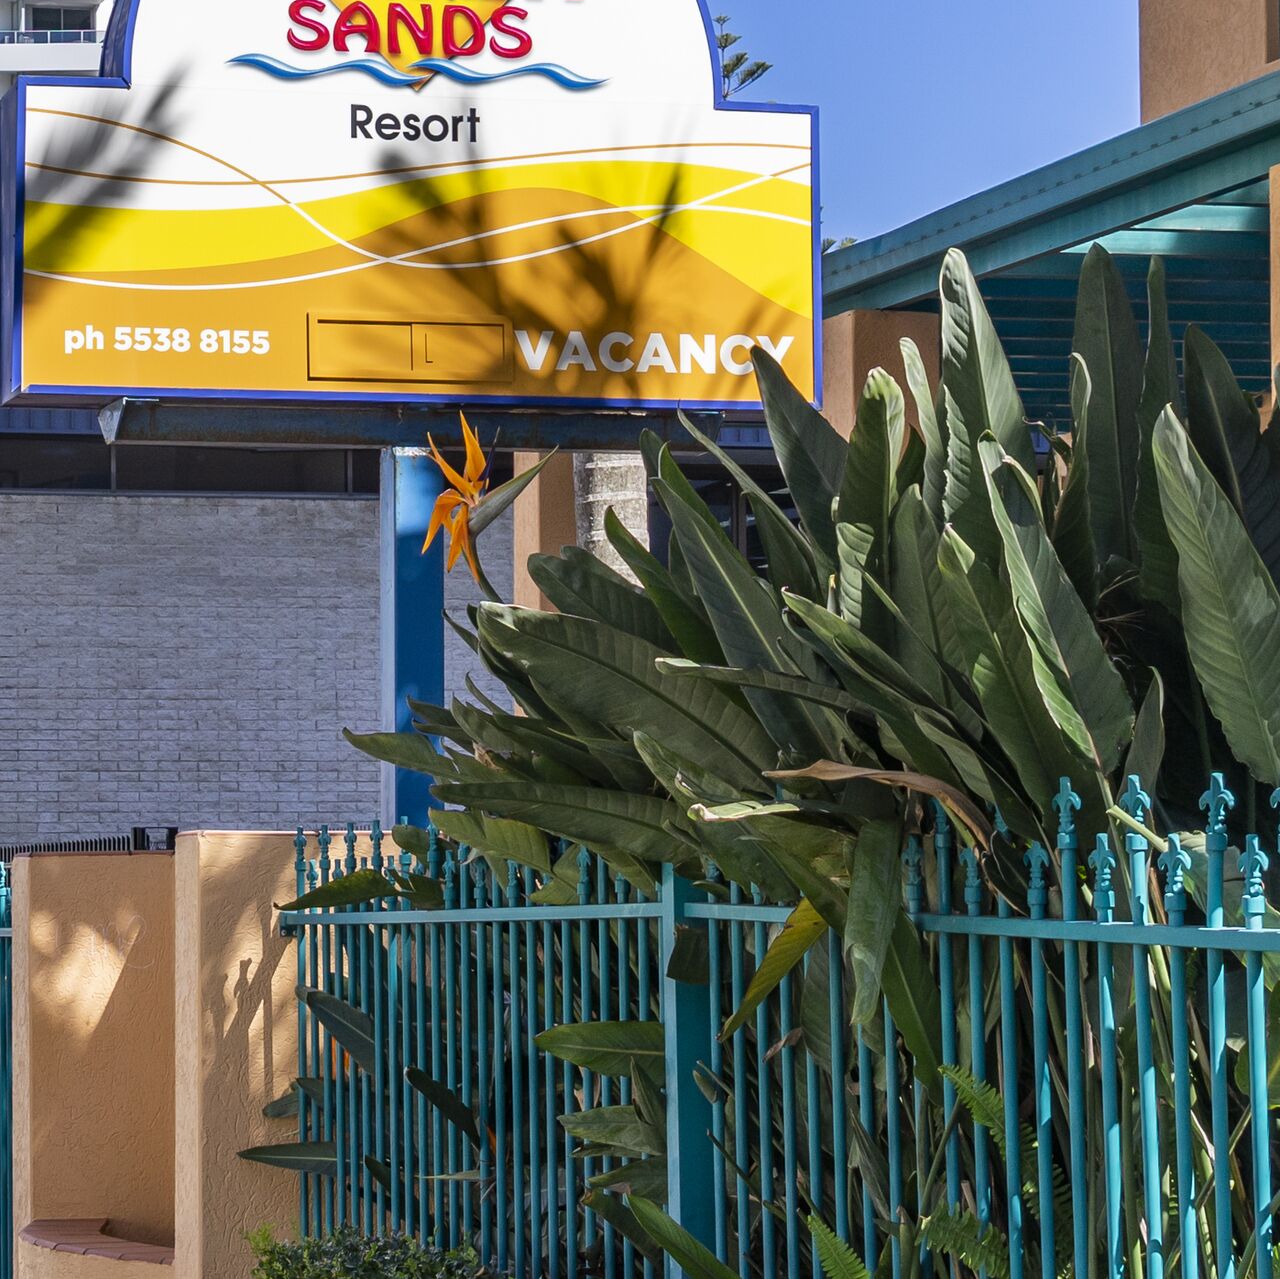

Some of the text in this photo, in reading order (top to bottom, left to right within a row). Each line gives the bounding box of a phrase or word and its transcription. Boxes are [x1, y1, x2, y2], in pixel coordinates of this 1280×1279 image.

[350, 103, 480, 143] Resort
[64, 324, 271, 355] ph 5538 8155
[514, 329, 795, 376] VACANCY
